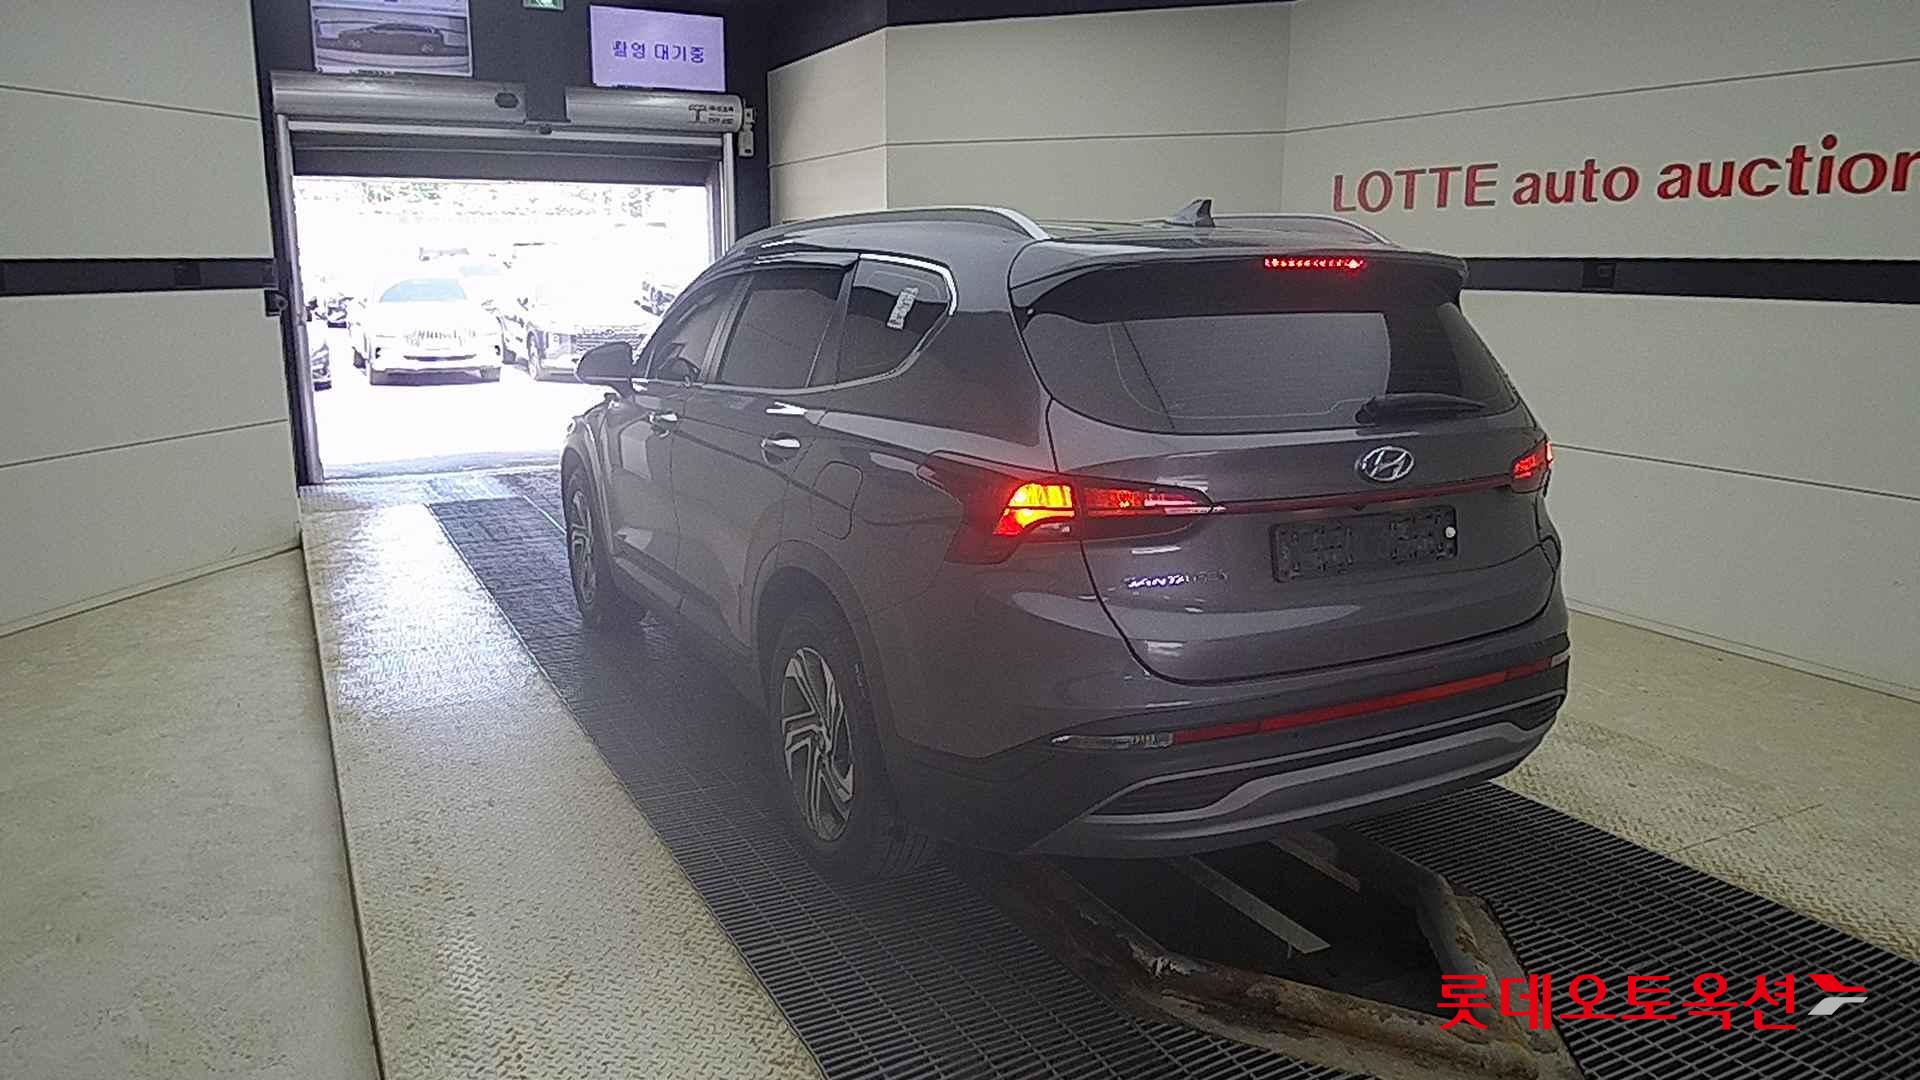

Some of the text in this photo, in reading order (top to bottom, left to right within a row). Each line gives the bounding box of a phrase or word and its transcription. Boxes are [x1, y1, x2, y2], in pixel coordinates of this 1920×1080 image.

[654, 43, 705, 64] 대기중
[1332, 162, 1500, 213] LOTTE
[1513, 158, 1640, 206] auto
